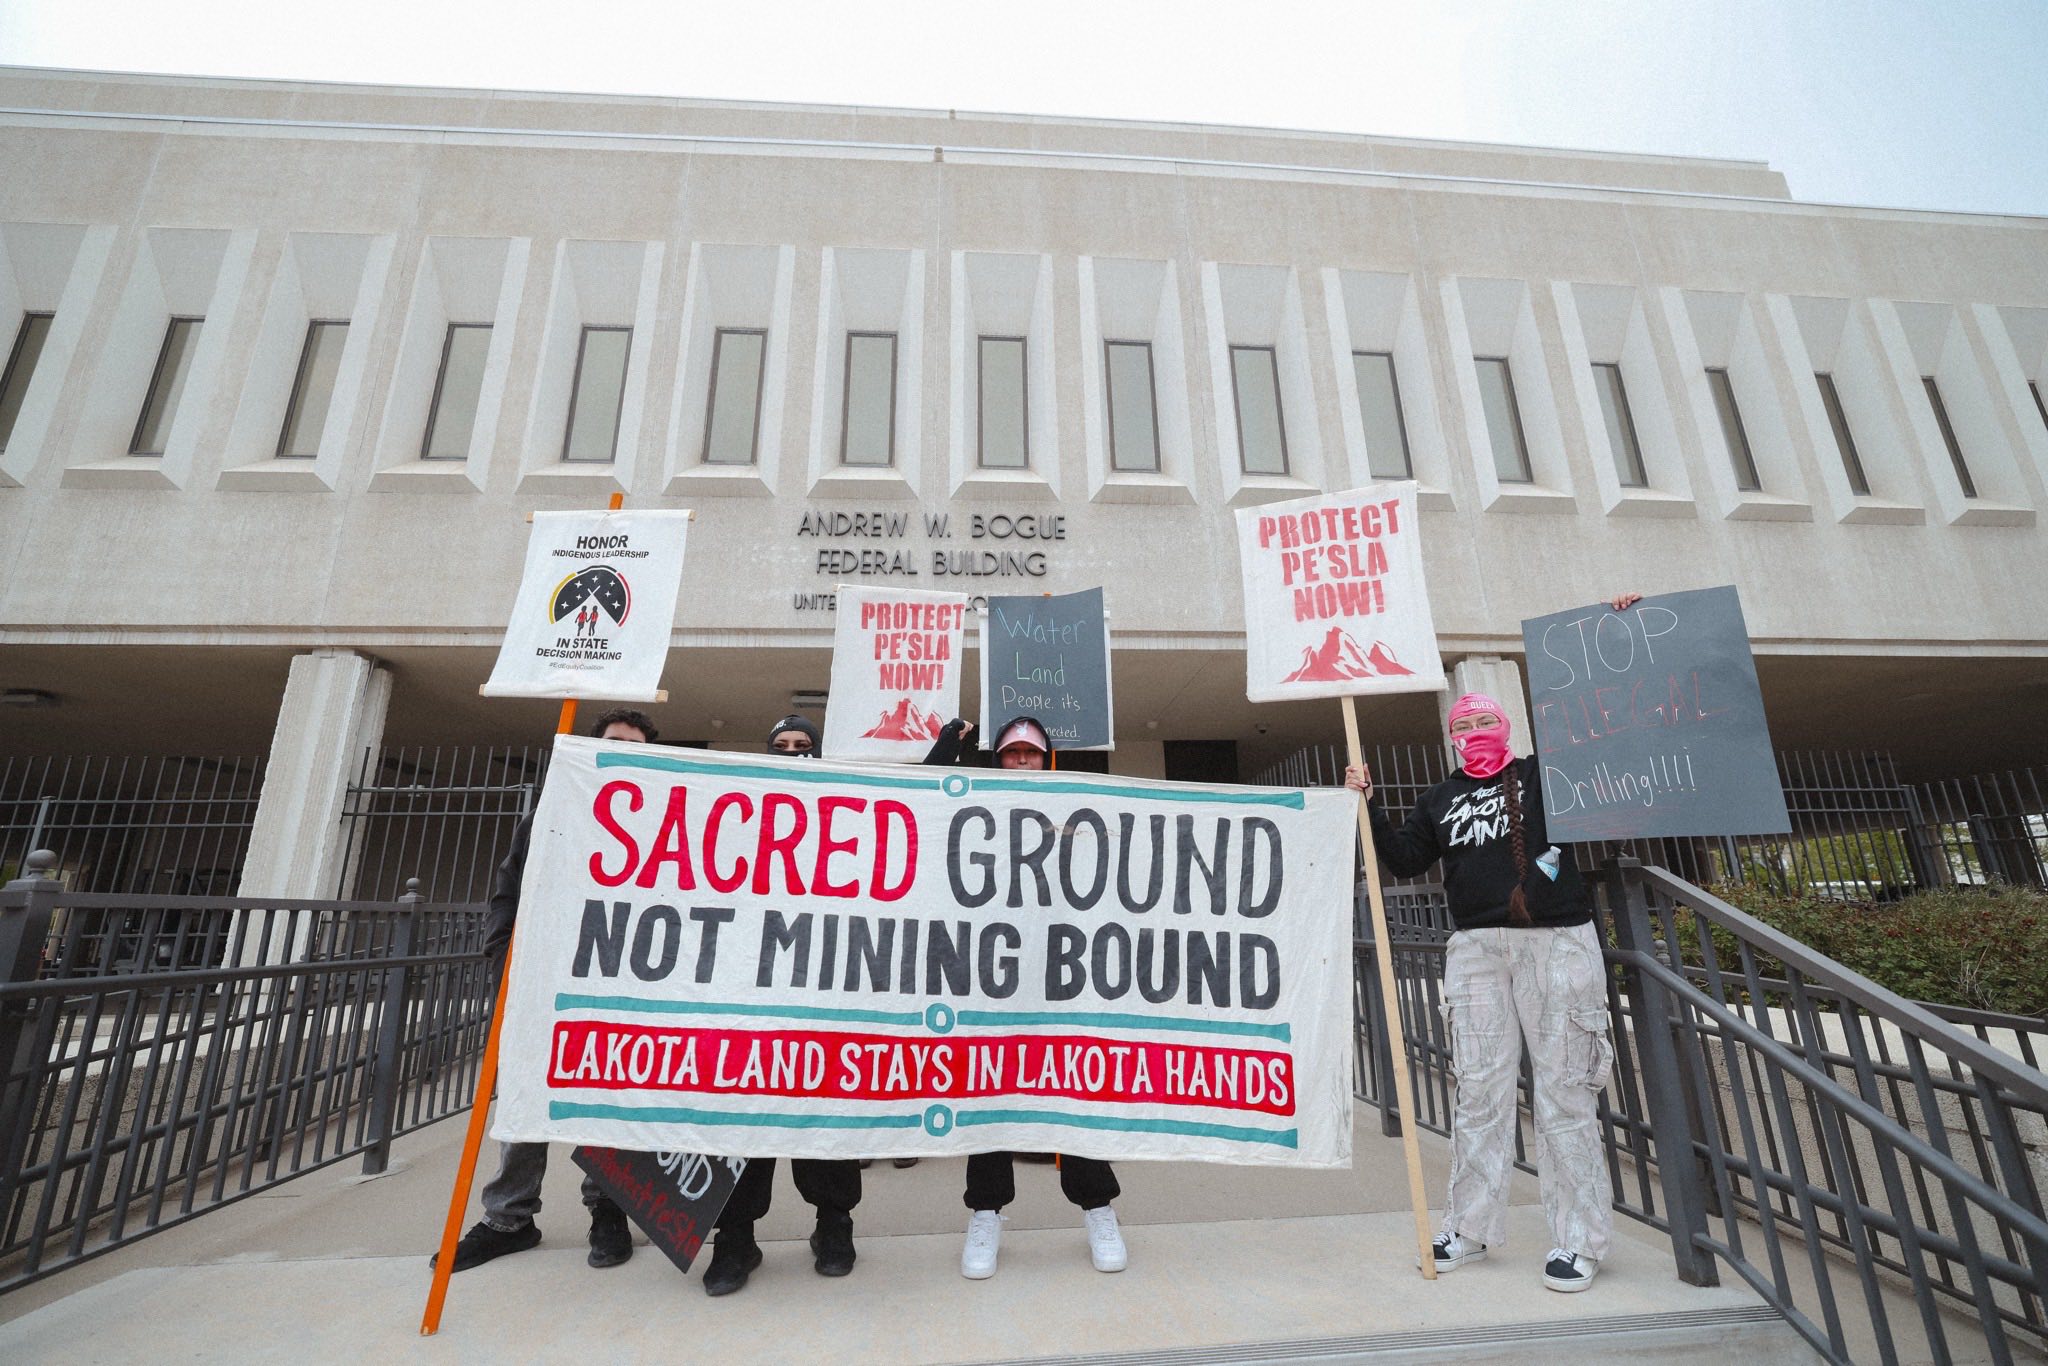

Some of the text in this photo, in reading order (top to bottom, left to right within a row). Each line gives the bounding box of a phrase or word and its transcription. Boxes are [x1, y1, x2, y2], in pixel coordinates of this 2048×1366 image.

[797, 511, 1066, 540] ANDREW W. BOGUE
[1259, 499, 1400, 549] PROTECT
[552, 549, 650, 559] INDIGENOUS LEADERSHIP
[576, 535, 629, 549] HONOR
[816, 549, 1047, 577] FEDERAL BUILDING
[1281, 542, 1389, 586] PE'SLA
[794, 593, 837, 611] UNITE
[1294, 580, 1385, 622] NOW!
[861, 602, 965, 631] PROTECT
[996, 607, 1086, 645] Water
[536, 647, 622, 661] DECISION MAKING
[556, 637, 609, 650] IN STATE
[874, 632, 950, 661] PE'SLA
[1543, 607, 1678, 690] STOP
[879, 663, 945, 691] NOW!
[1016, 652, 1065, 687] Land
[1062, 692, 1081, 712] it's
[1536, 671, 1730, 753] ILLEGAL
[589, 780, 1284, 918] SACRED GROUND
[572, 899, 1281, 1010] NOT MINING BOUND
[555, 1030, 1289, 1107] LAKOTA LAND STAYS IN LAKOTA HANDS
